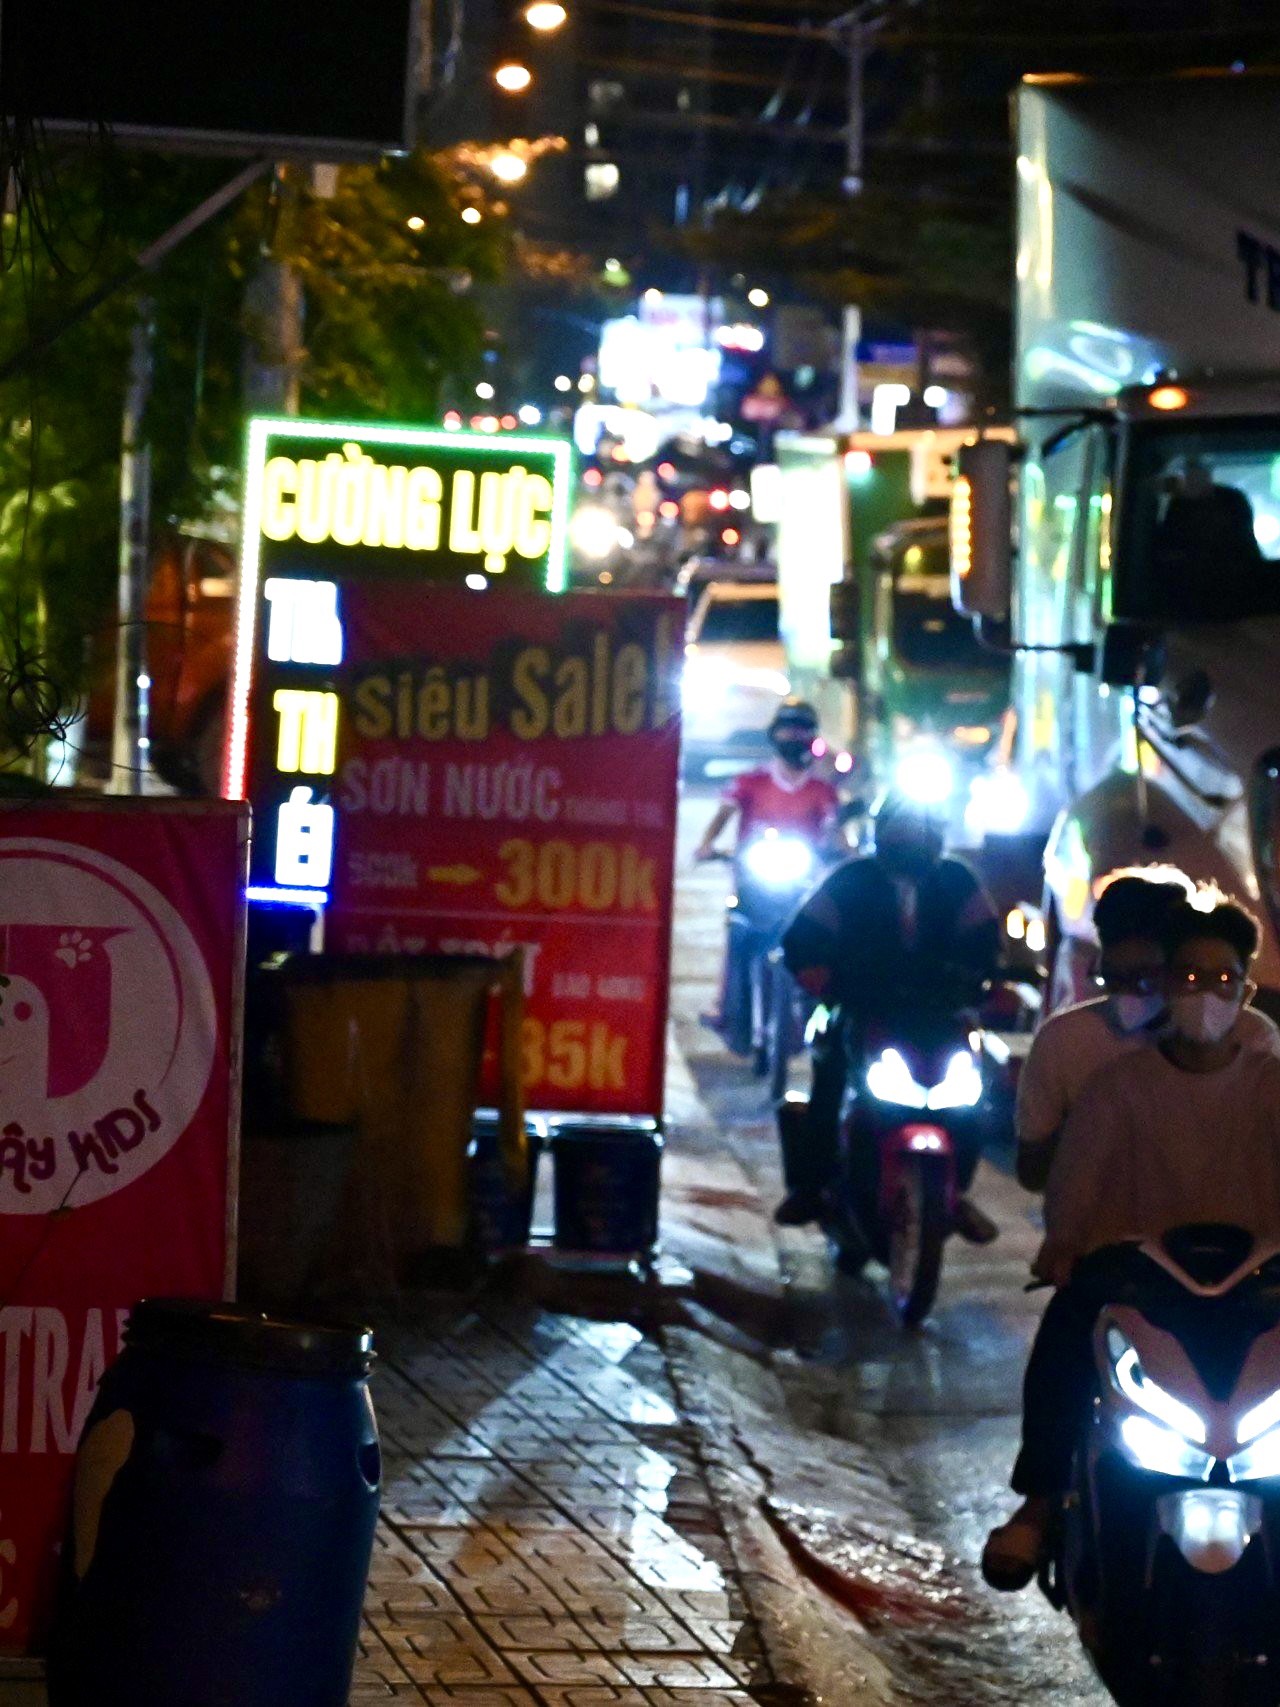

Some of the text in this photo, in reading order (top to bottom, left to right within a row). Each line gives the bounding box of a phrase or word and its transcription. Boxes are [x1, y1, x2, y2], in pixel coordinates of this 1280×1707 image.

[262, 442, 553, 573] CƯỜNG LỰC
[0, 1306, 131, 1454] TRA
